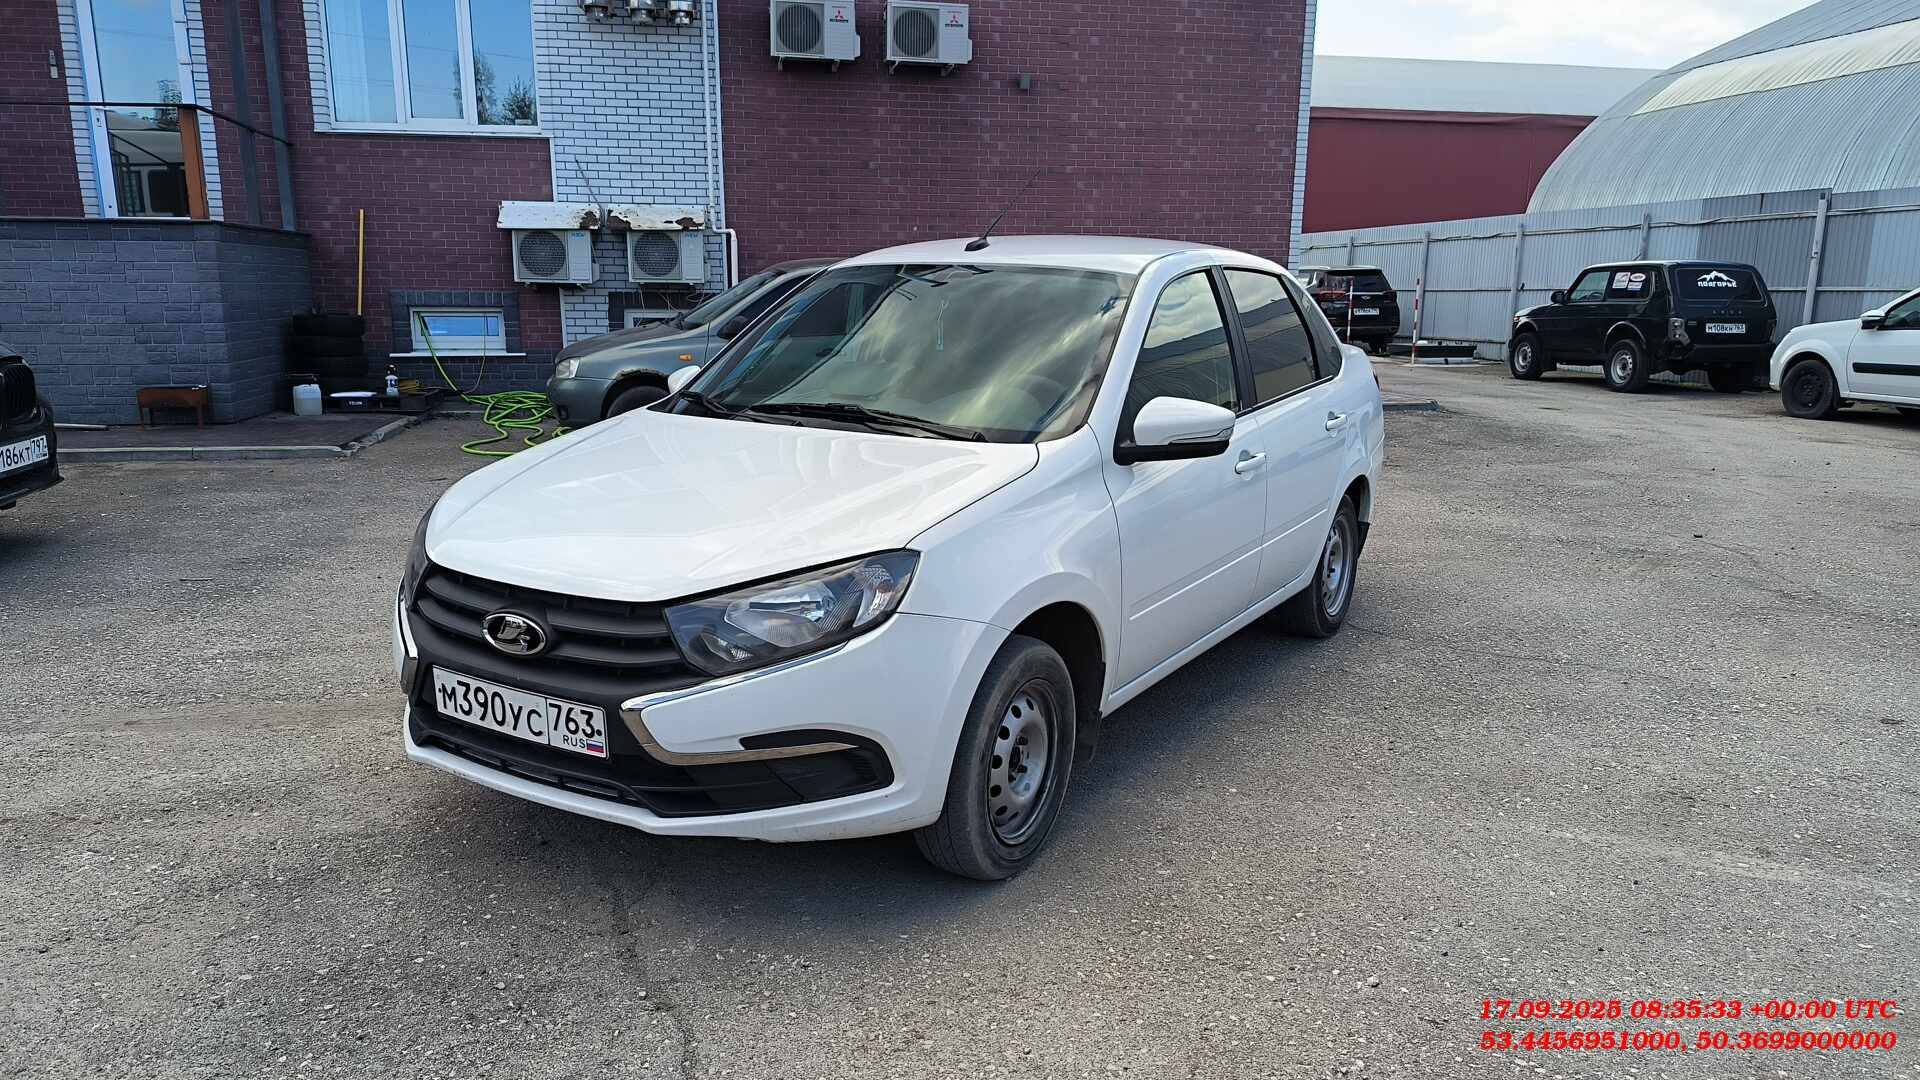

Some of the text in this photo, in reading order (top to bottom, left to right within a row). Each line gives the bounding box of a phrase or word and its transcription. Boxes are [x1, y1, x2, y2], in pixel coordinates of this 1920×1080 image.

[440, 679, 596, 739] М390УС 763
[562, 734, 587, 749] RUS
